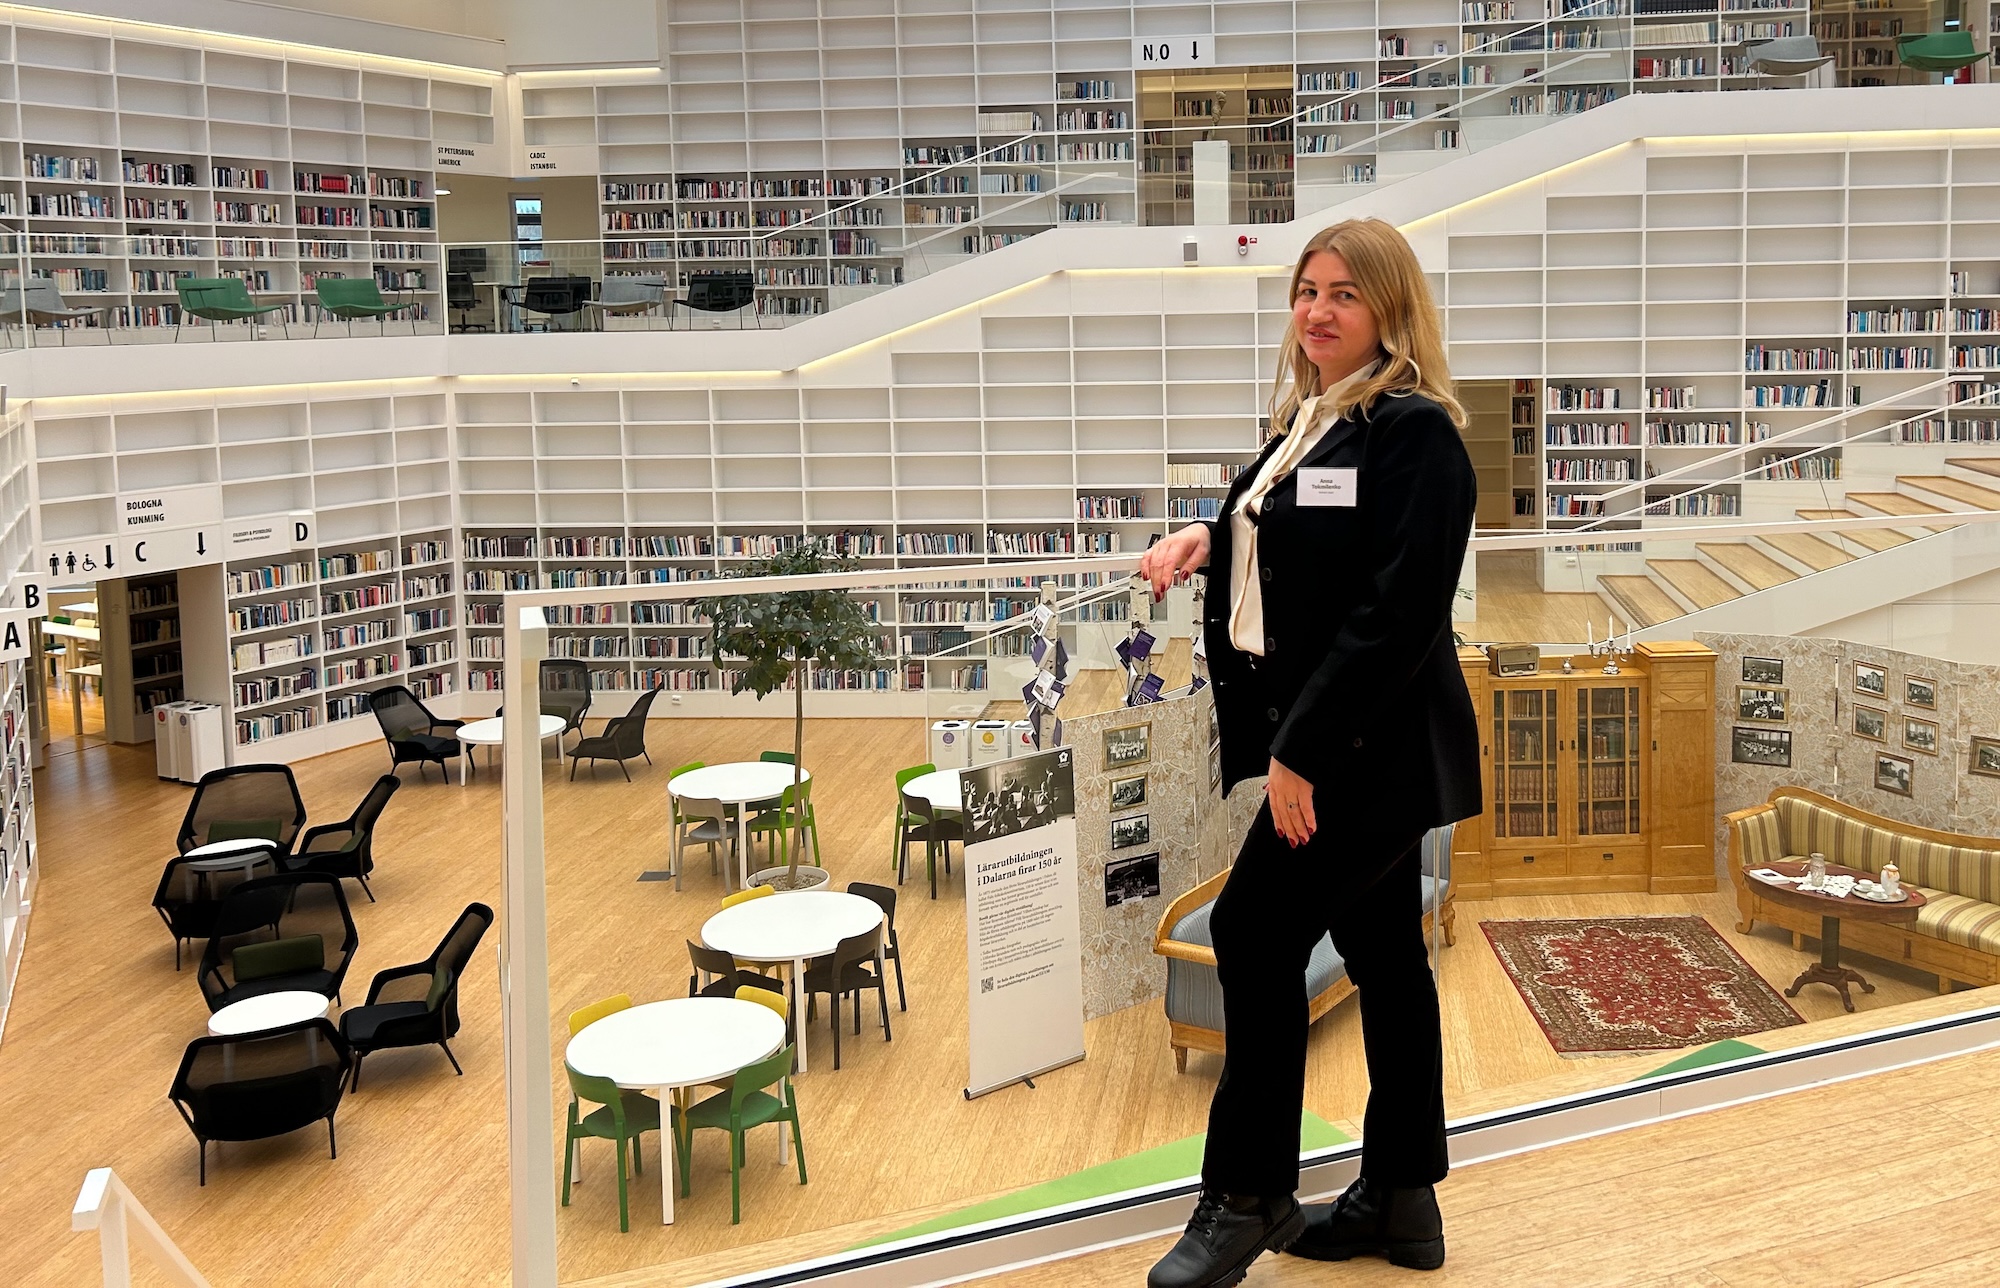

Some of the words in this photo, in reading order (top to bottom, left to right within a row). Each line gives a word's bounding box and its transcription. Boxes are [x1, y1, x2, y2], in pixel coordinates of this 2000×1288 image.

[438, 158, 461, 167] LIMERICK
[444, 147, 475, 157] PETERSBURG
[126, 498, 163, 511] BOLOGNA
[127, 513, 165, 526] KUNMING
[294, 522, 309, 542] D
[135, 541, 147, 563] C
[24, 584, 40, 609] B
[3, 621, 22, 651] A
[977, 847, 1053, 873] Lärarutbildningen
[977, 876, 981, 887] i
[982, 870, 1017, 885] Dalarna
[1018, 864, 1037, 876] firar
[1038, 858, 1052, 870] 150
[1053, 856, 1062, 865] år
